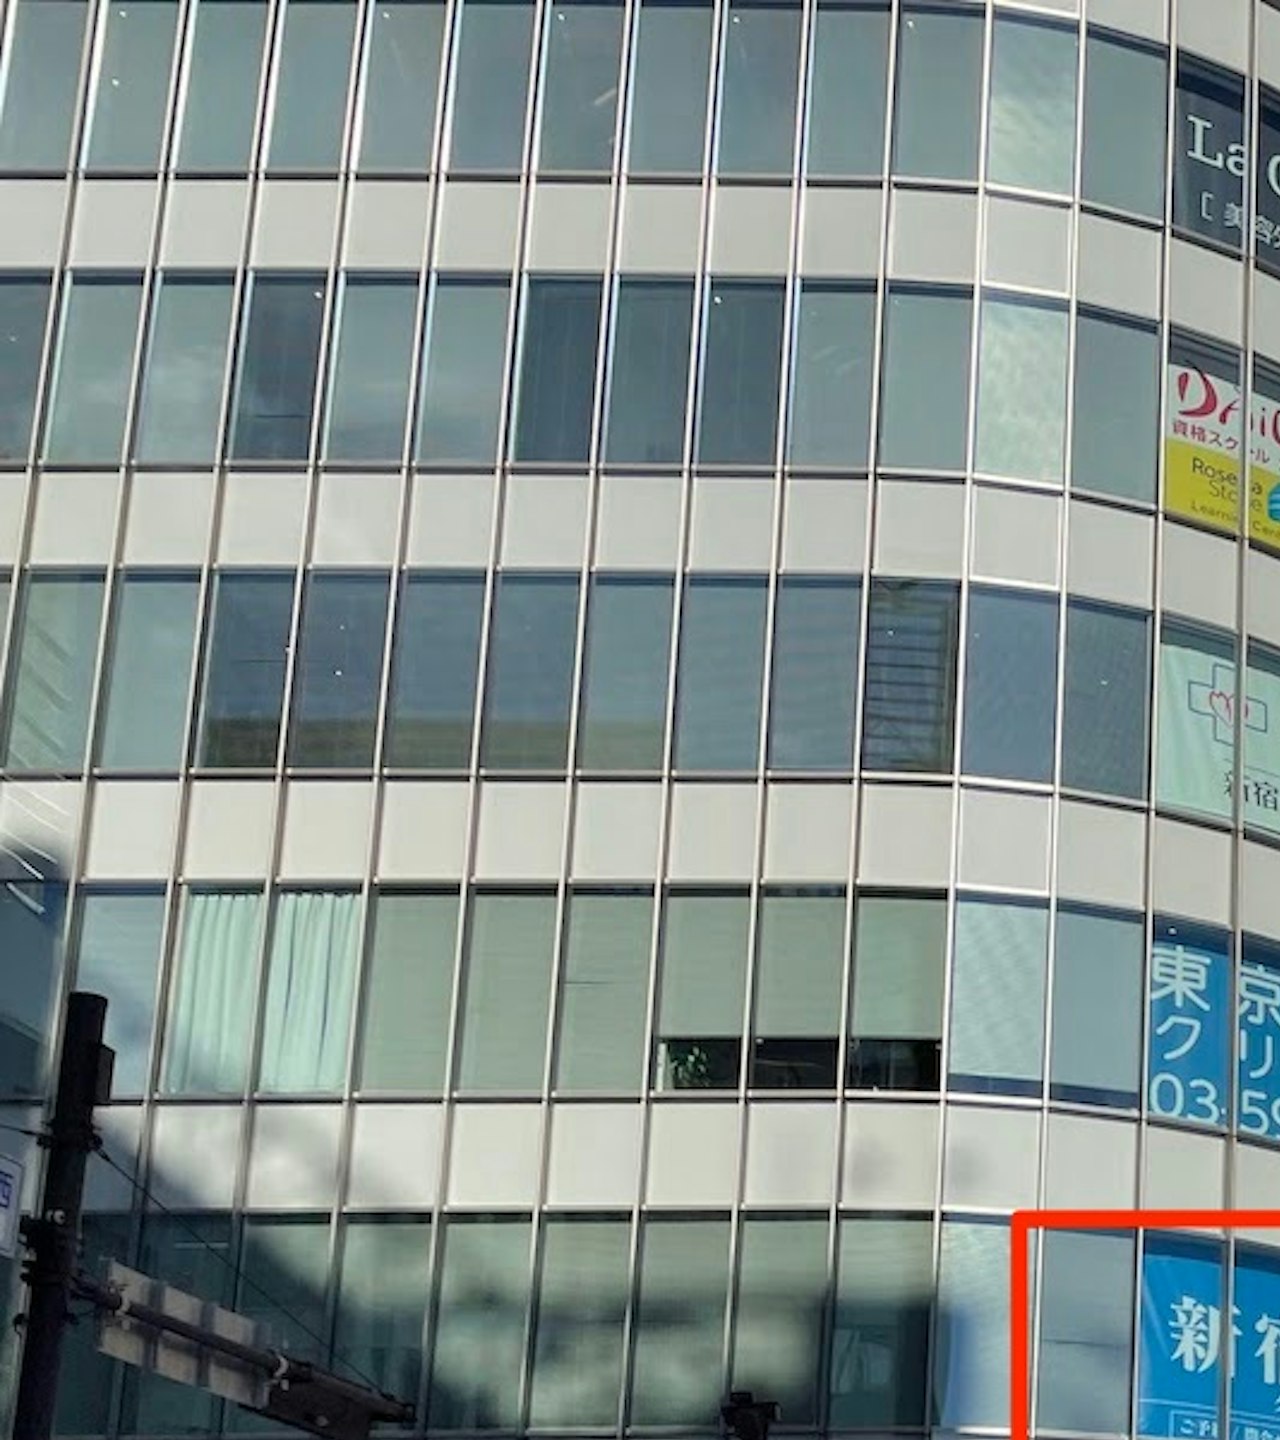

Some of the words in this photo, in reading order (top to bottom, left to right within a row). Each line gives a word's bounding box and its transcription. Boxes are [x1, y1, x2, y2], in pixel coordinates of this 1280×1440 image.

[1186, 115, 1247, 177] La
[1173, 419, 1270, 465] 資格スクル
[1191, 457, 1263, 497] Rosea
